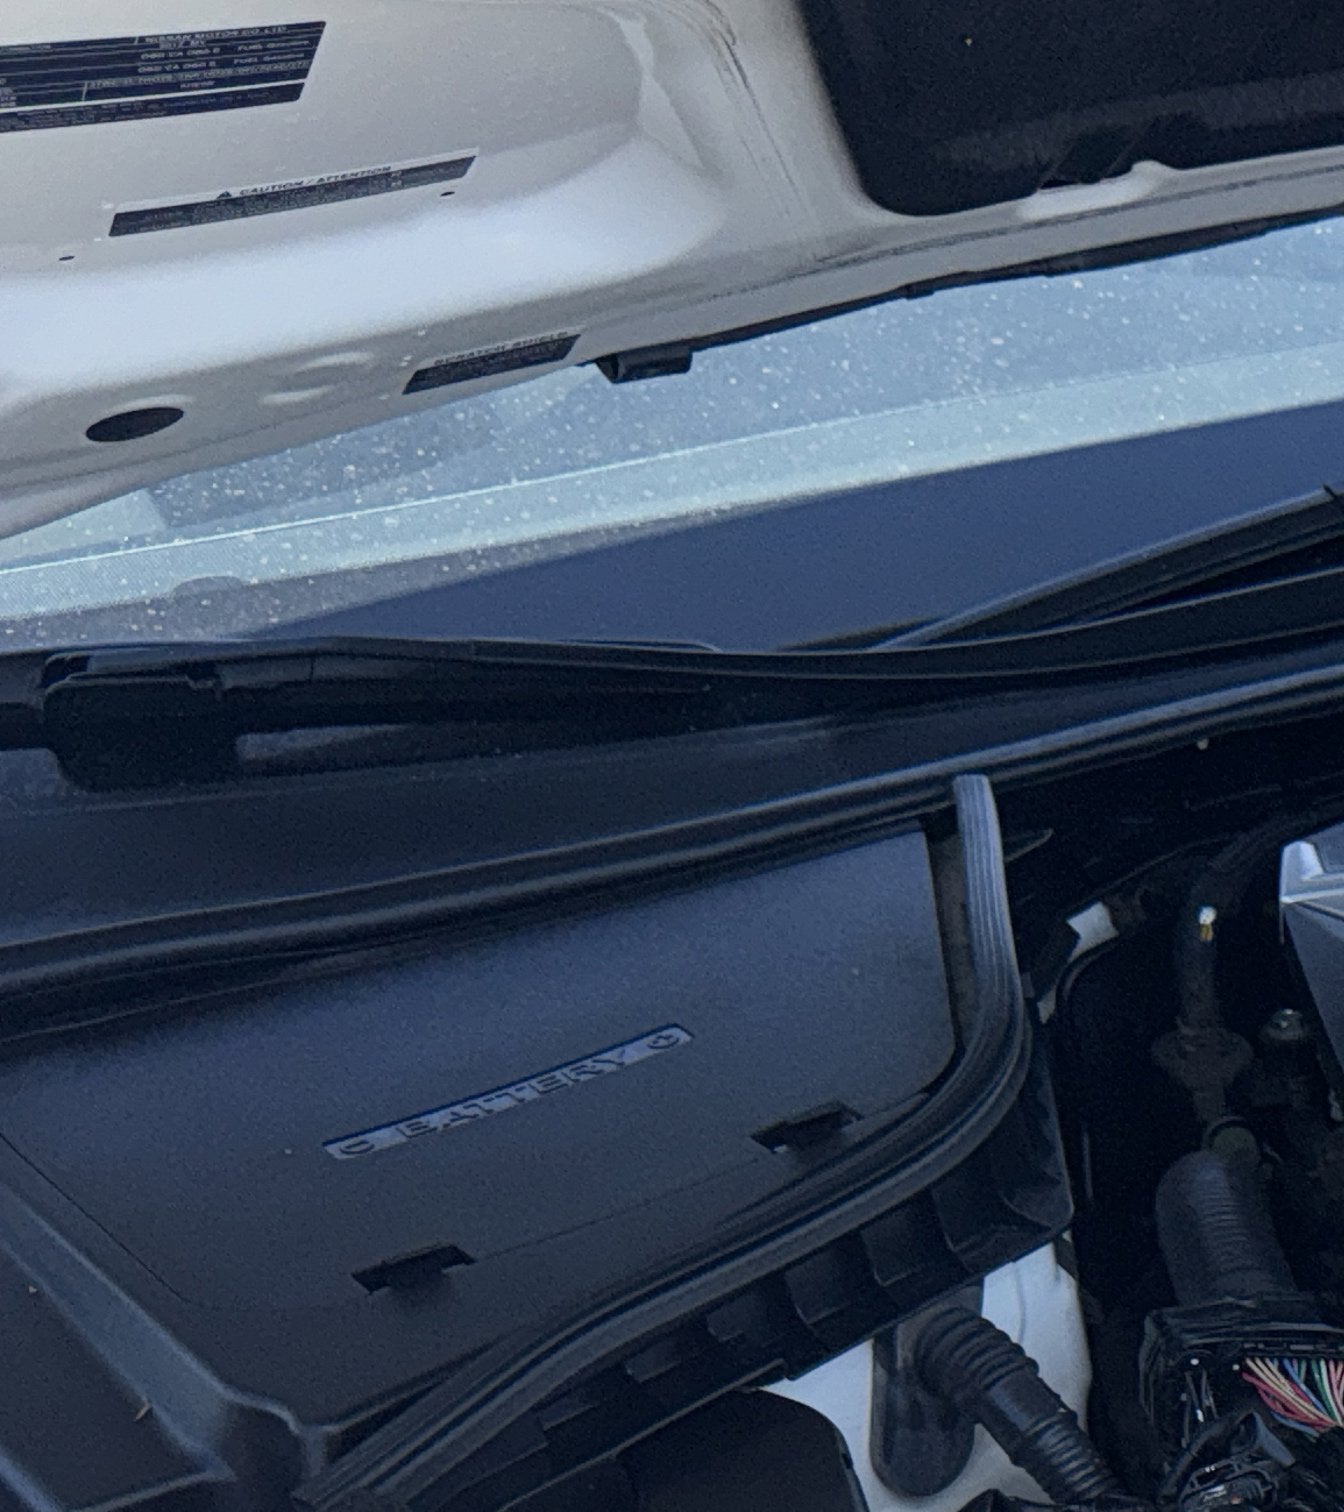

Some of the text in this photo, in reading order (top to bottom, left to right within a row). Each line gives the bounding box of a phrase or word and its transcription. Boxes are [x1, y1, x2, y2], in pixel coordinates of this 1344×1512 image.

[239, 180, 304, 195] CAUTION
[316, 165, 392, 183] ATTENTION
[396, 1048, 627, 1140] BATTERY
